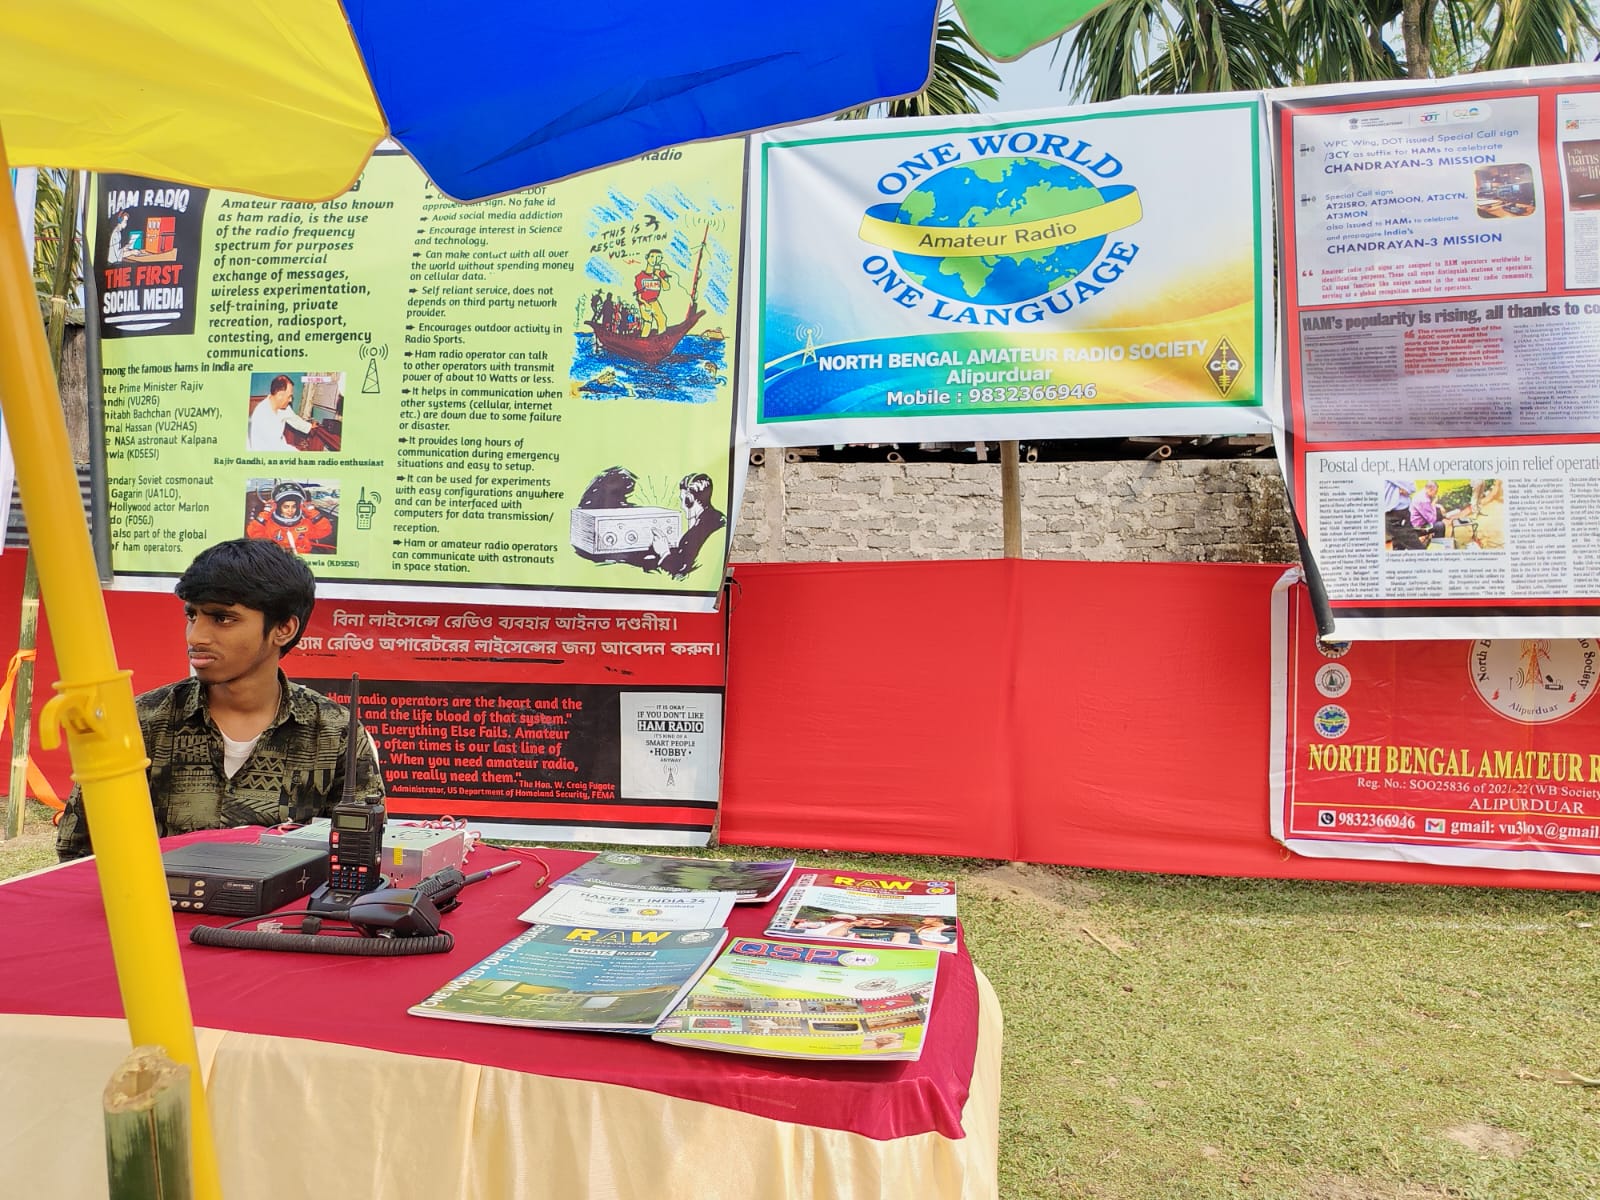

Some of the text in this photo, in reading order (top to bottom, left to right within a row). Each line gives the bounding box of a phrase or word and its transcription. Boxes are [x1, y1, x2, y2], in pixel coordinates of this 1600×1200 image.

[877, 132, 1124, 198] ONE WORLD
[1324, 154, 1495, 174] CHANDRAYAN-3 MISSION
[107, 189, 190, 218] HAM RADIO
[1326, 210, 1367, 220] AT3MON
[601, 224, 640, 240] THIS IS
[918, 221, 1077, 248] Amateur Radio
[590, 232, 667, 253] RESCUE STATION
[1327, 233, 1502, 254] CHANDRAYAN-3 MISSION
[214, 253, 327, 269] of non-commercial
[105, 264, 183, 288] THE FIRST
[212, 269, 348, 282] exchange of messages,
[211, 284, 370, 298] wireless experimentation,
[861, 241, 1140, 327] ONE LANGUAGE
[103, 288, 183, 313] SOCIAL MEDIA
[209, 299, 338, 313] self-training, private
[209, 315, 346, 328] recreation, radiosport,
[1302, 316, 1342, 331] HAM's
[1345, 312, 1415, 330] popularity
[1418, 311, 1431, 323] is
[1434, 309, 1481, 323] rising,
[1485, 307, 1503, 320] all
[1507, 304, 1560, 318] thanks
[1564, 303, 1579, 315] to
[208, 330, 371, 345] contesting, and emergency
[206, 346, 307, 358] communications.
[819, 340, 1207, 371] NORTH BENGAL AMATEUR RADIO SOCIETY
[946, 367, 1053, 386] Alipurduar
[119, 381, 203, 393] Prime Minister Rajiv
[887, 384, 1097, 406] Mobile 9832366946
[214, 457, 234, 465] Rajiv
[235, 457, 265, 465] Gandhi,
[340, 458, 383, 466] enthusiast
[1319, 458, 1357, 472] Postal
[1398, 457, 1429, 471] HAM
[1433, 459, 1493, 474] operators
[1495, 457, 1519, 473] join
[1522, 456, 1554, 470] relief
[1556, 456, 1600, 473] operati
[404, 538, 425, 547] Ham
[441, 541, 481, 549] amateur
[484, 540, 509, 550] radio
[512, 543, 557, 552] operators
[412, 552, 475, 561] communicate
[478, 552, 499, 562] with
[502, 555, 554, 563] astronauts
[392, 561, 470, 572] in space station.
[333, 609, 365, 626] বিনা
[369, 610, 440, 627] লাইসেন্সে
[444, 611, 492, 628] রেডিও
[498, 616, 551, 629] ব্যবহার
[555, 613, 611, 630] আইনত
[327, 634, 373, 650] রেডিও
[379, 636, 470, 652] অপারেটরের
[474, 636, 558, 653] লাইসেন্সের
[561, 641, 596, 655] জন্য
[601, 641, 665, 655] আবেদন
[1577, 651, 1595, 690] Society
[357, 693, 582, 710] radio operators are the heart and the
[1508, 702, 1559, 715] Alipurduar
[638, 721, 704, 732] HAM RADIO
[654, 748, 686, 756] HOBBY
[1308, 744, 1584, 782] NORTH BENGAL AMATEUR
[392, 785, 614, 798] Administrator, US Department of Homeland Security, FEMA
[1357, 777, 1380, 790] Reg.
[1473, 783, 1486, 793] of
[1469, 798, 1584, 814] ALIPURDUAR
[1338, 812, 1415, 829] 9832366946
[1450, 821, 1494, 834] gmail:
[833, 875, 913, 890] RAW
[566, 928, 672, 944] RAW
[732, 940, 838, 962] QSP
[421, 990, 449, 1007] ONE
[447, 969, 485, 993] WORLD
[484, 952, 510, 966] ONE
